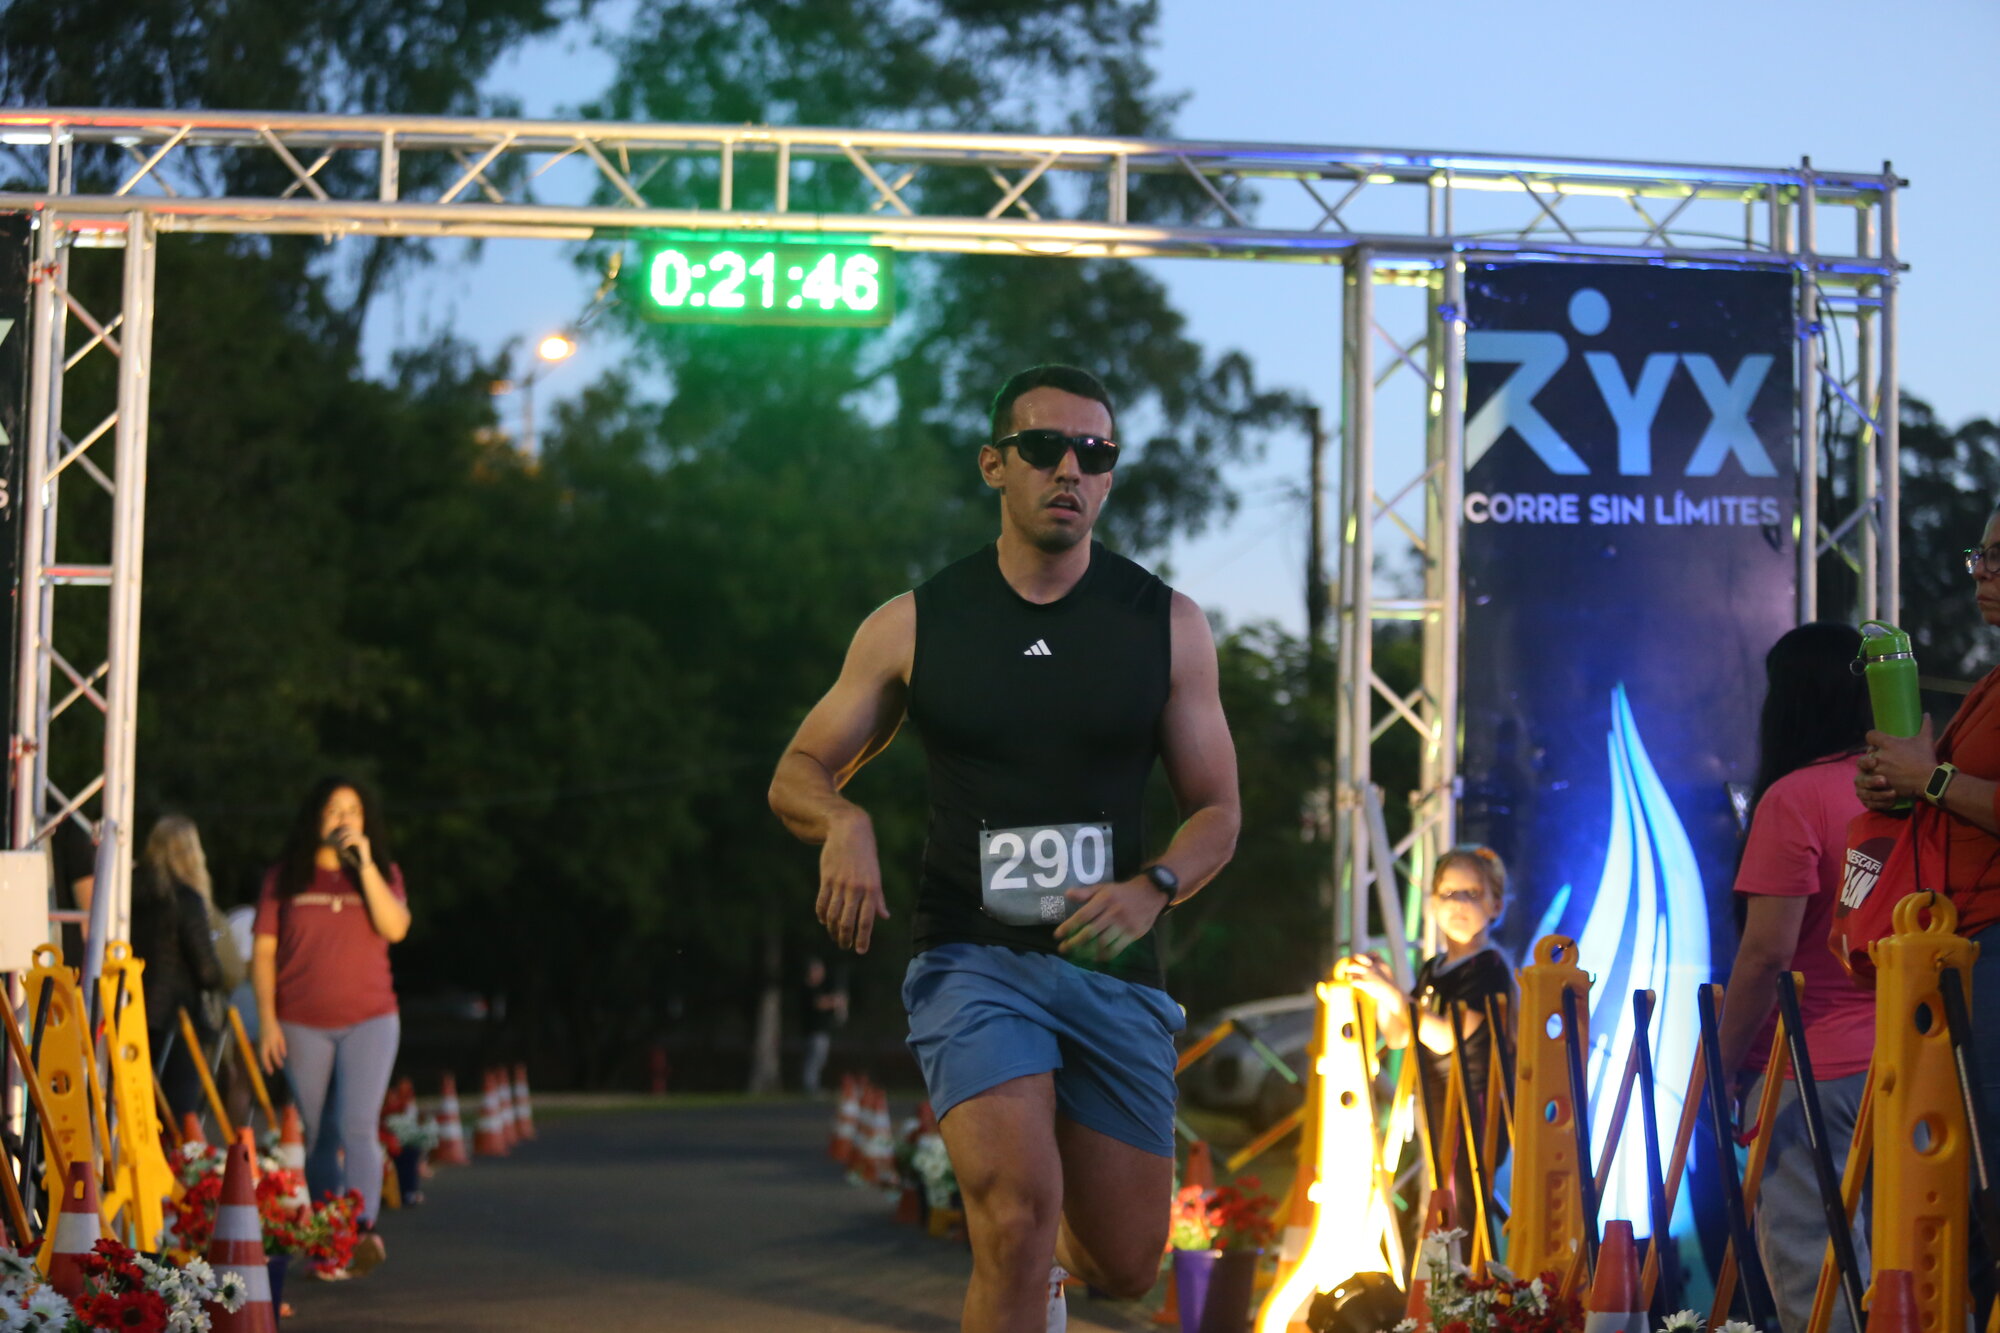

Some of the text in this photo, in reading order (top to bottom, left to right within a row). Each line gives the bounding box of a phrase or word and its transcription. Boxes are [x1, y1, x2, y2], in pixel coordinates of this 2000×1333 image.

[650, 249, 879, 311] 0:21:46
[1464, 489, 1781, 526] CORRE SIN LÍMITES
[988, 826, 1106, 890] 290
